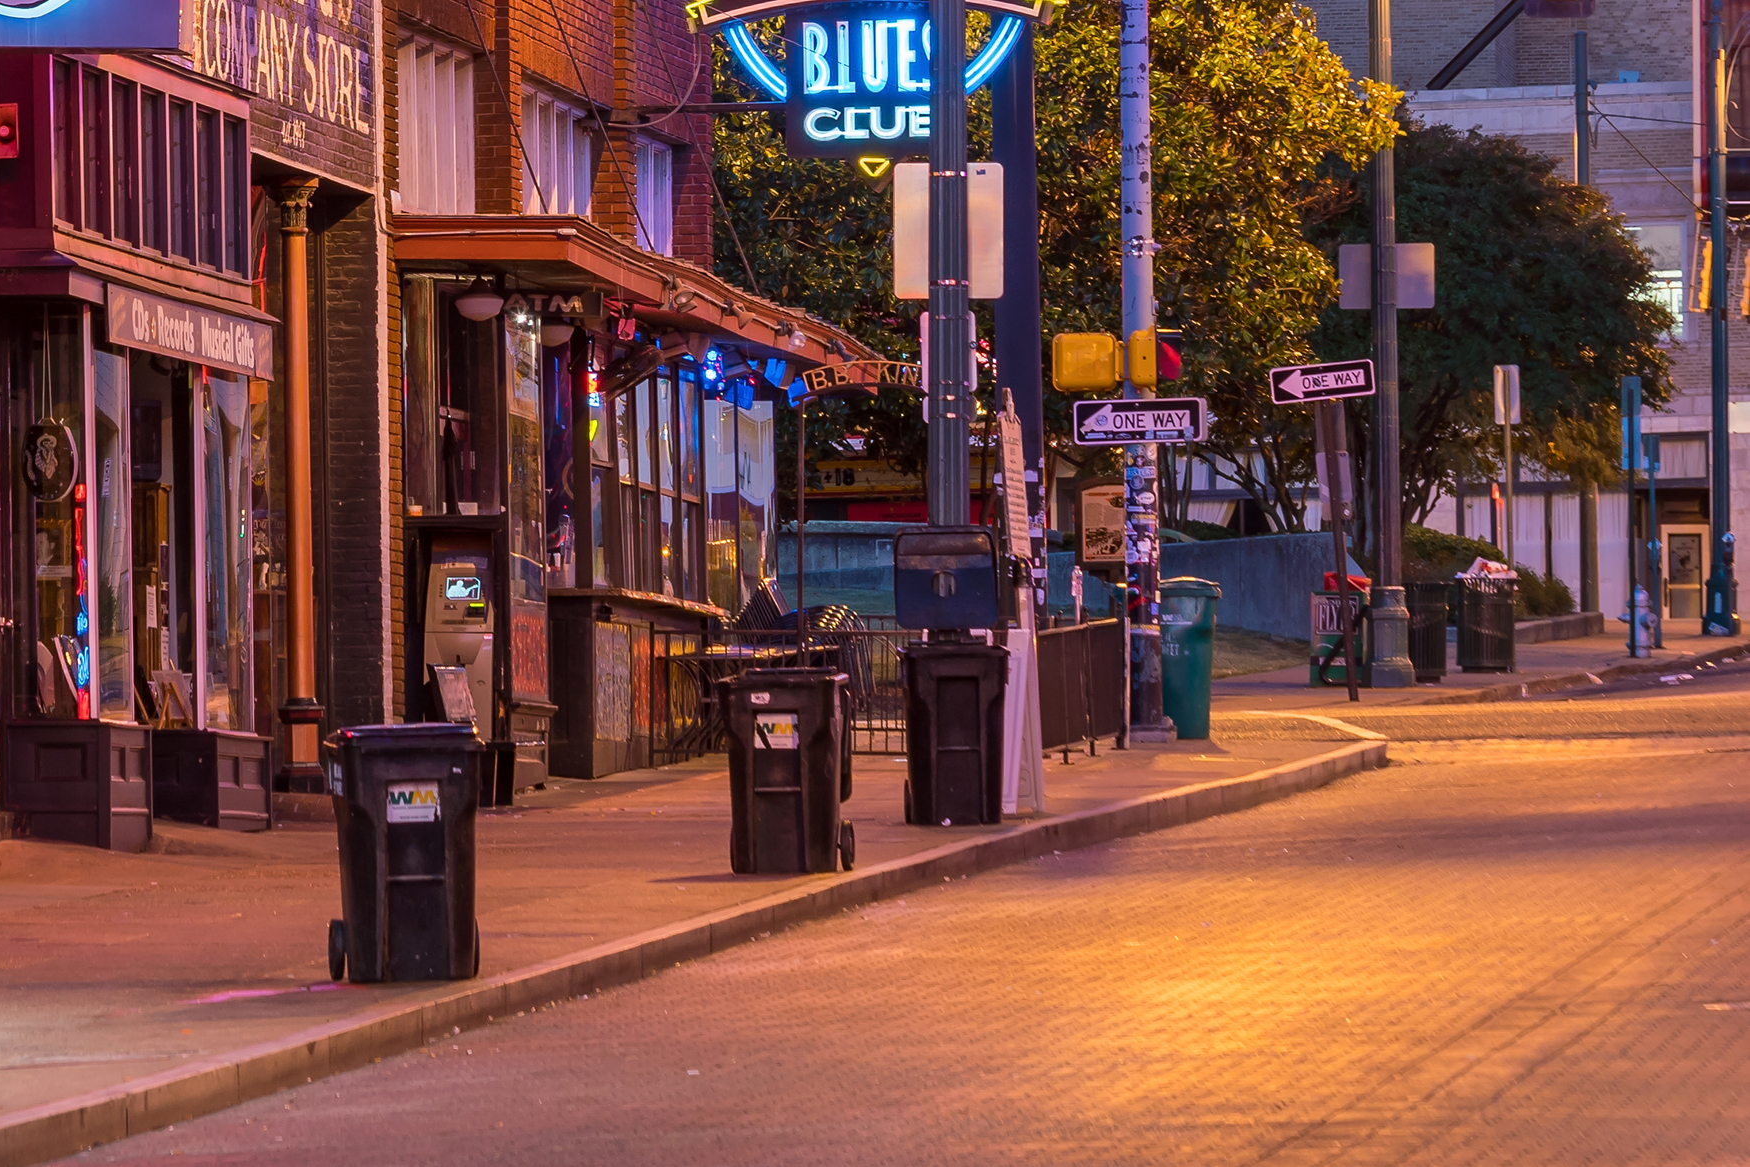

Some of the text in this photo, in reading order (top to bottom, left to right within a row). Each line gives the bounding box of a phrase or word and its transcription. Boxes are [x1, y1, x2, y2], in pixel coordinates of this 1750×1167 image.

[803, 18, 931, 95] BLUE
[303, 25, 370, 135] STORE
[503, 293, 584, 313] ATM
[131, 297, 256, 369] CDs Records Musical Gifts
[811, 363, 921, 391] B.B. KIN
[1333, 371, 1361, 386] WAY
[1112, 411, 1187, 430] ONE WAY
[389, 790, 437, 805] WM
